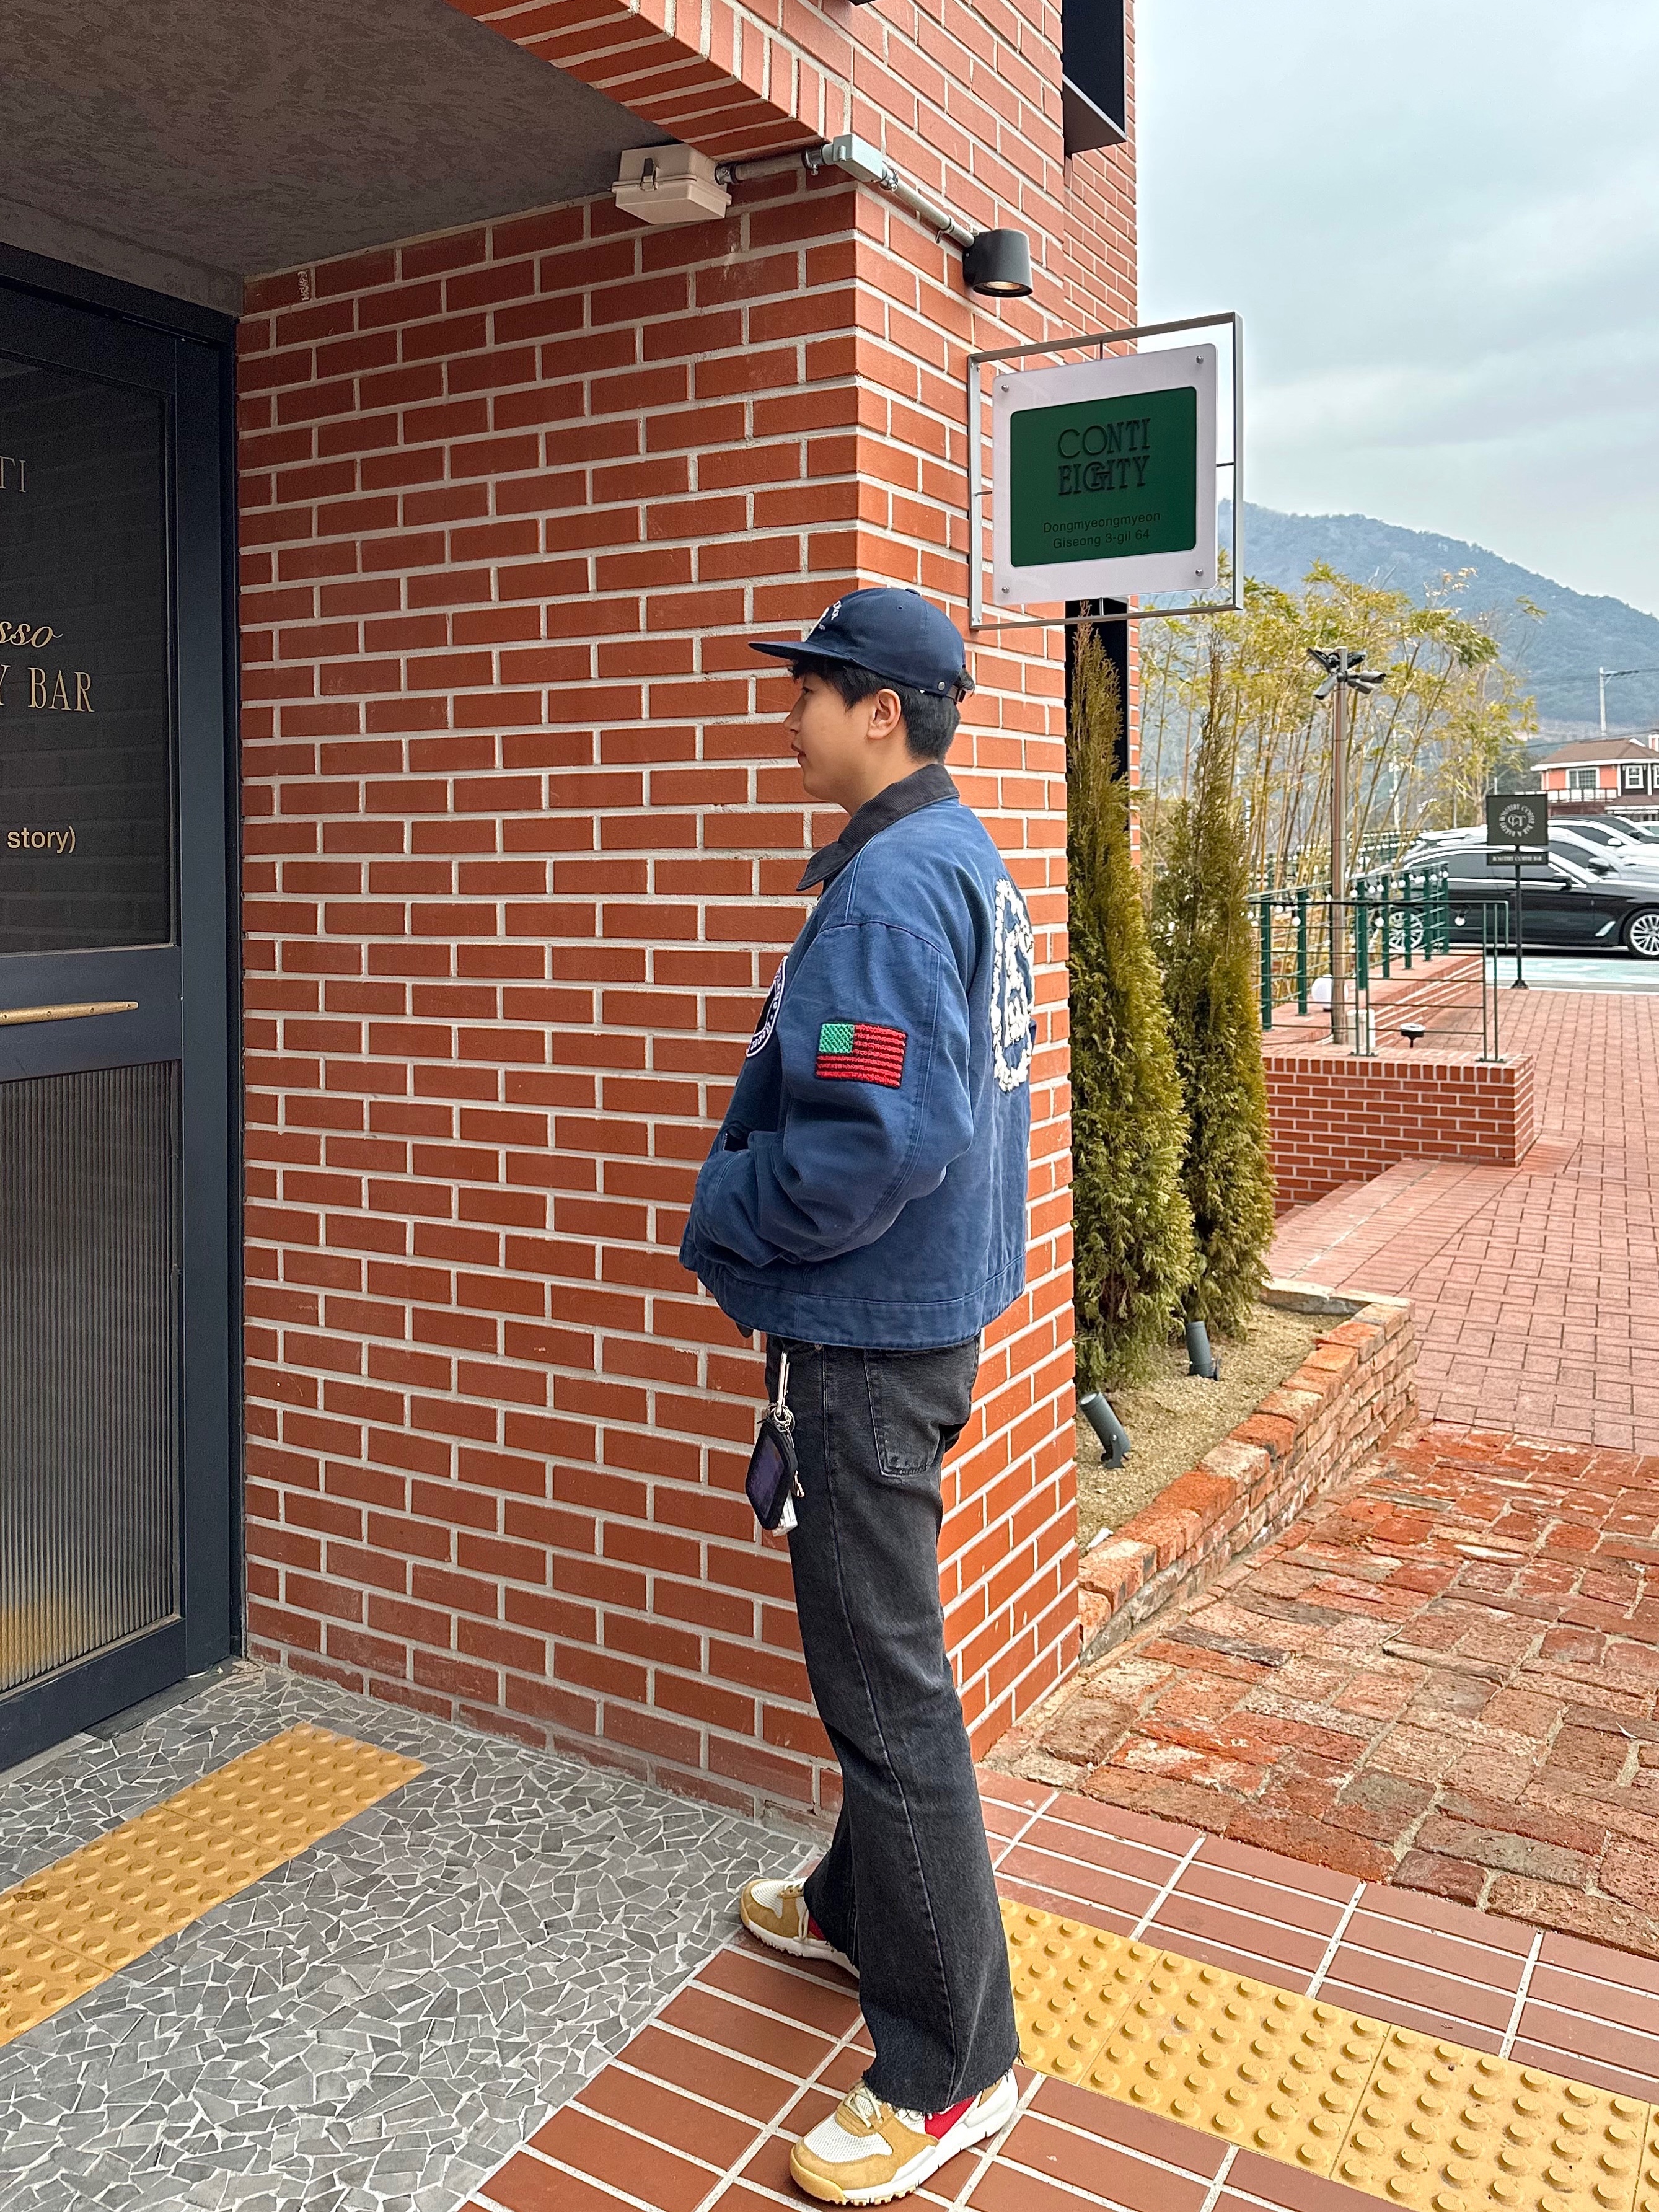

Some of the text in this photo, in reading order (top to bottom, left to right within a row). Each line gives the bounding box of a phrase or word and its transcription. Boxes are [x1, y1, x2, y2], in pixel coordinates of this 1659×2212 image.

[1058, 418, 1151, 459] CONTI
[1044, 512, 1161, 533] Dongmyeongmyeon
[1053, 529, 1150, 549] Giseong 3-gil 64
[27, 666, 95, 713] BAR
[7, 825, 76, 854] story)
